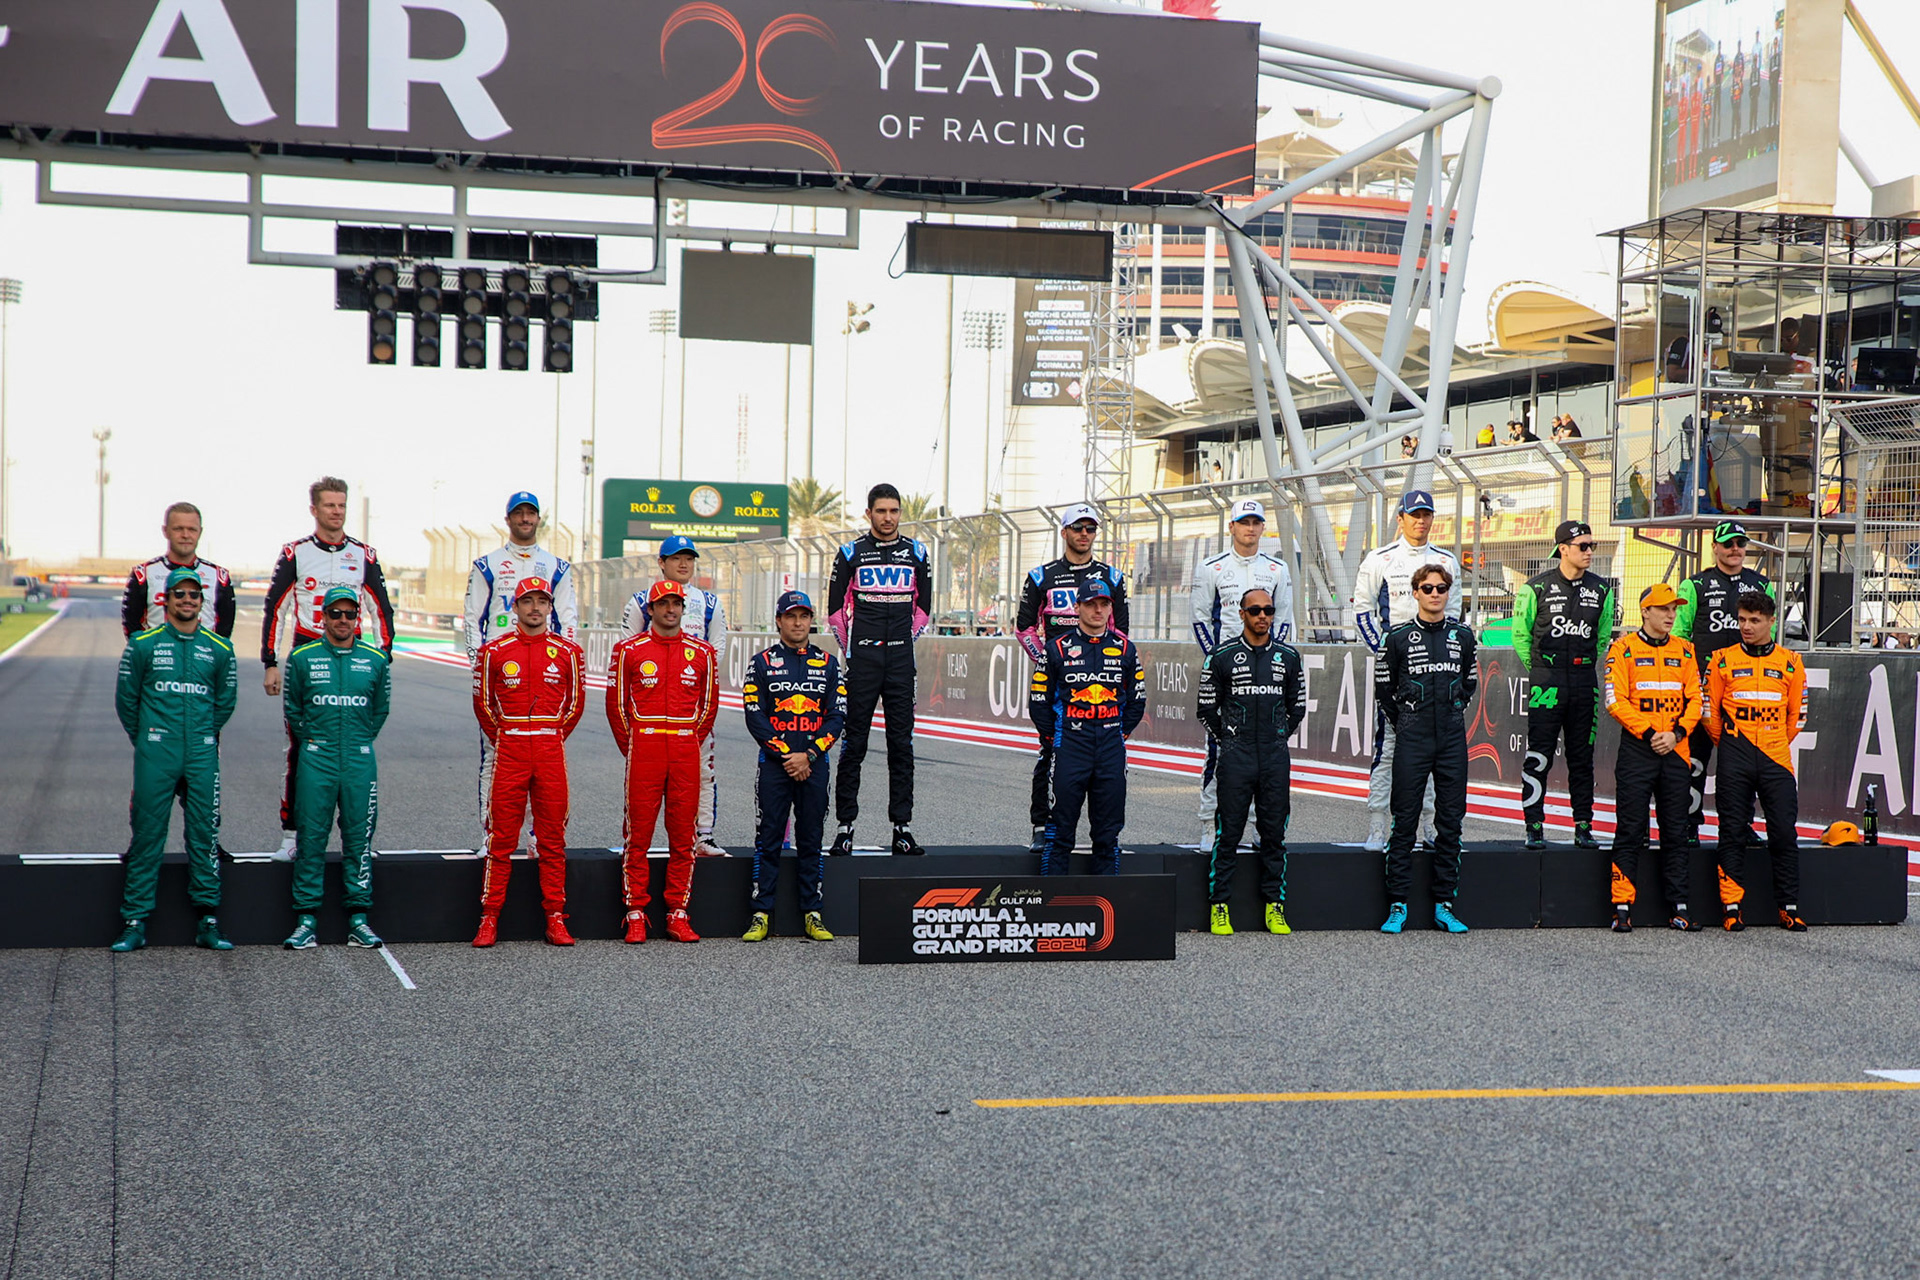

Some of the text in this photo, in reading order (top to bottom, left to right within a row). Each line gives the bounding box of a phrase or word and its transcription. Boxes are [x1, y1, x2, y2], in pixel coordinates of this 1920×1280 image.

[106, 0, 513, 140] AIR
[865, 37, 1101, 102] YEARS
[878, 114, 1086, 150] OF RACING
[1023, 310, 1060, 318] PORSCHE
[1036, 361, 1077, 369] FORMULA
[630, 502, 676, 515] ROLEX
[734, 506, 780, 518] ROLEX
[1715, 522, 1731, 539] 17
[859, 566, 913, 588] BWT
[1579, 586, 1600, 600] Stake
[1550, 615, 1592, 638] Stake
[946, 653, 968, 679] YEARS
[1408, 661, 1461, 675] PETRONAS
[1065, 672, 1123, 683] ORACLE
[1155, 661, 1189, 694] YEARS
[155, 681, 210, 695] aramco
[768, 681, 827, 693] ORACLE
[1231, 685, 1283, 696] PETRONAS
[312, 694, 368, 706] aramco
[1031, 694, 1046, 702] VISA
[1529, 685, 1559, 709] 24
[1066, 705, 1119, 719] Red Bull
[1156, 703, 1186, 721] OF RACING
[769, 715, 823, 732] Red Bull
[1509, 733, 1522, 752] OF
[357, 781, 378, 890] ASTON MARTIN
[1000, 896, 1043, 905] GULF AIR
[912, 907, 1026, 923] FORMULA 1
[912, 921, 1096, 939] GULF AIR BAHRAIN
[912, 938, 1087, 955] GRAND PRIX 2024
